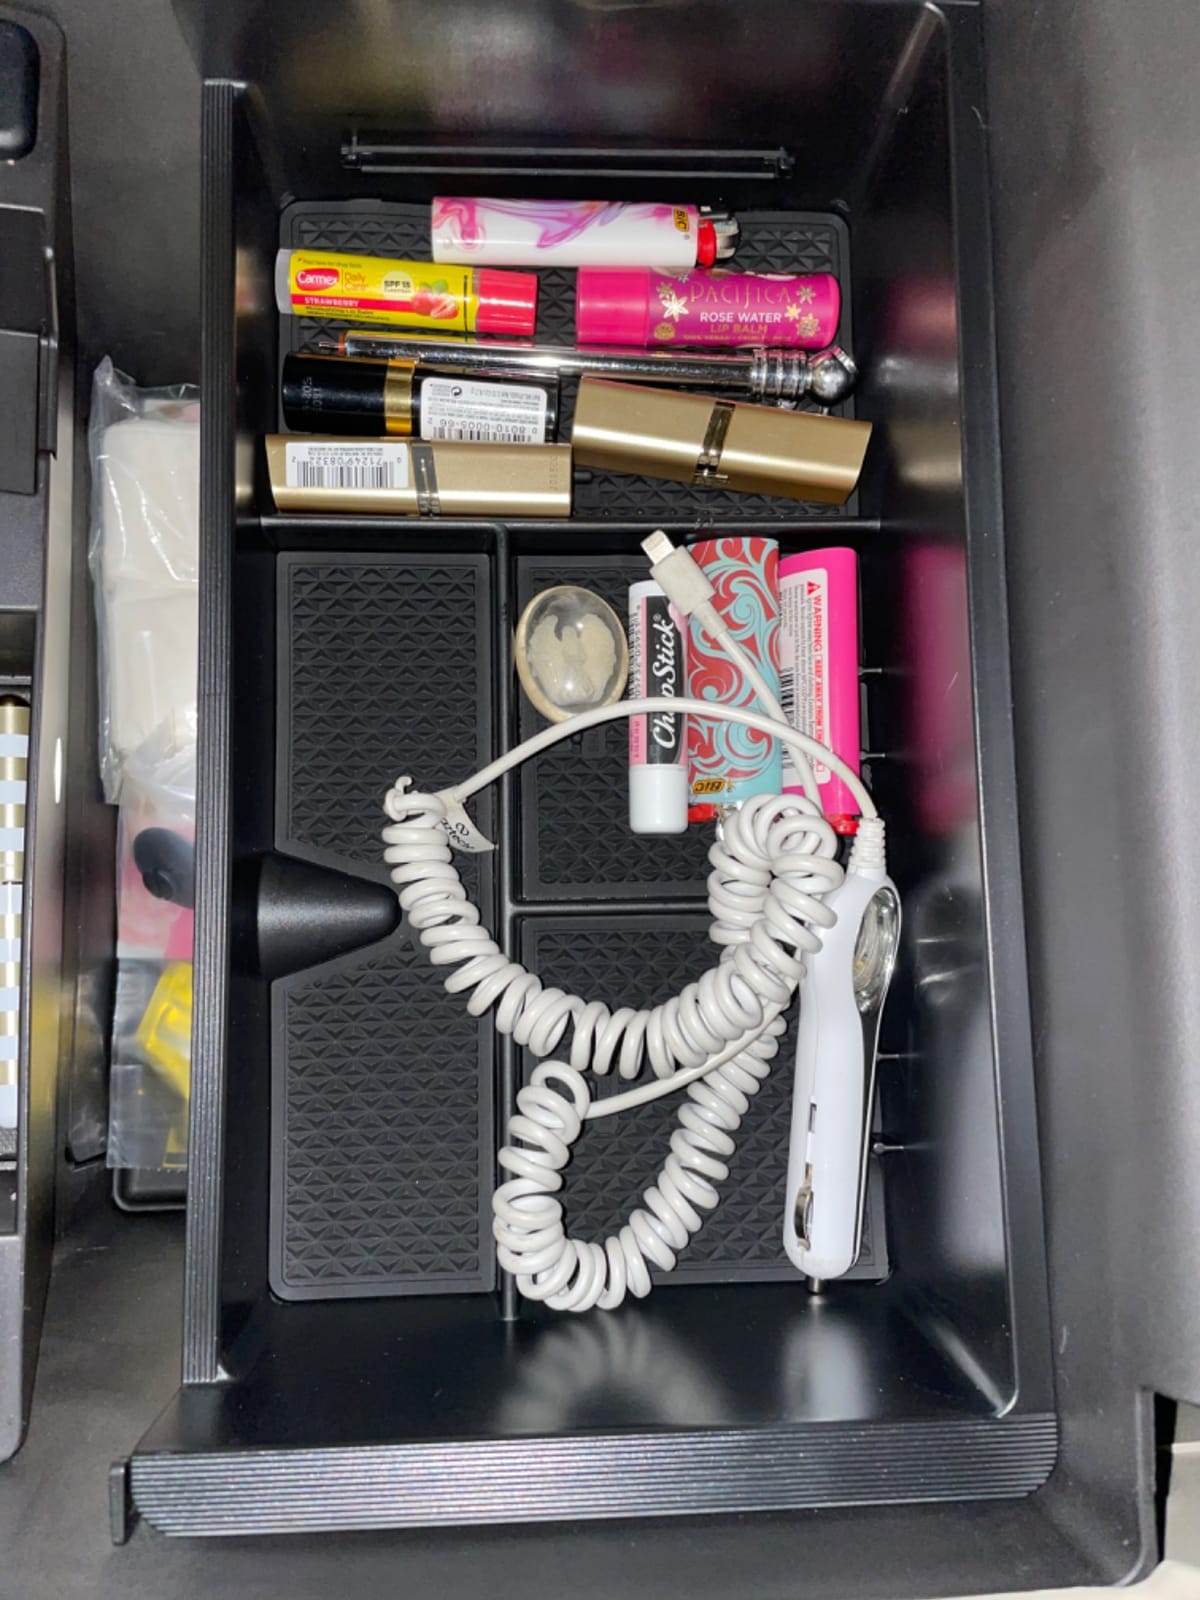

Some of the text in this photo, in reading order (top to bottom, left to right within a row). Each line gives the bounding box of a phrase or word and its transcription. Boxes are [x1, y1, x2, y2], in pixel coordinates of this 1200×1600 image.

[675, 209, 688, 231] BIC
[297, 271, 338, 286] Carmex
[304, 296, 359, 307] STRAWBERRY
[690, 282, 791, 309] PACIFICA
[700, 312, 782, 323] ROSE WATER
[710, 324, 768, 333] LIP BALM
[813, 594, 823, 652] WARNING
[652, 618, 676, 749] ChpStick
[694, 781, 722, 793] BIC
